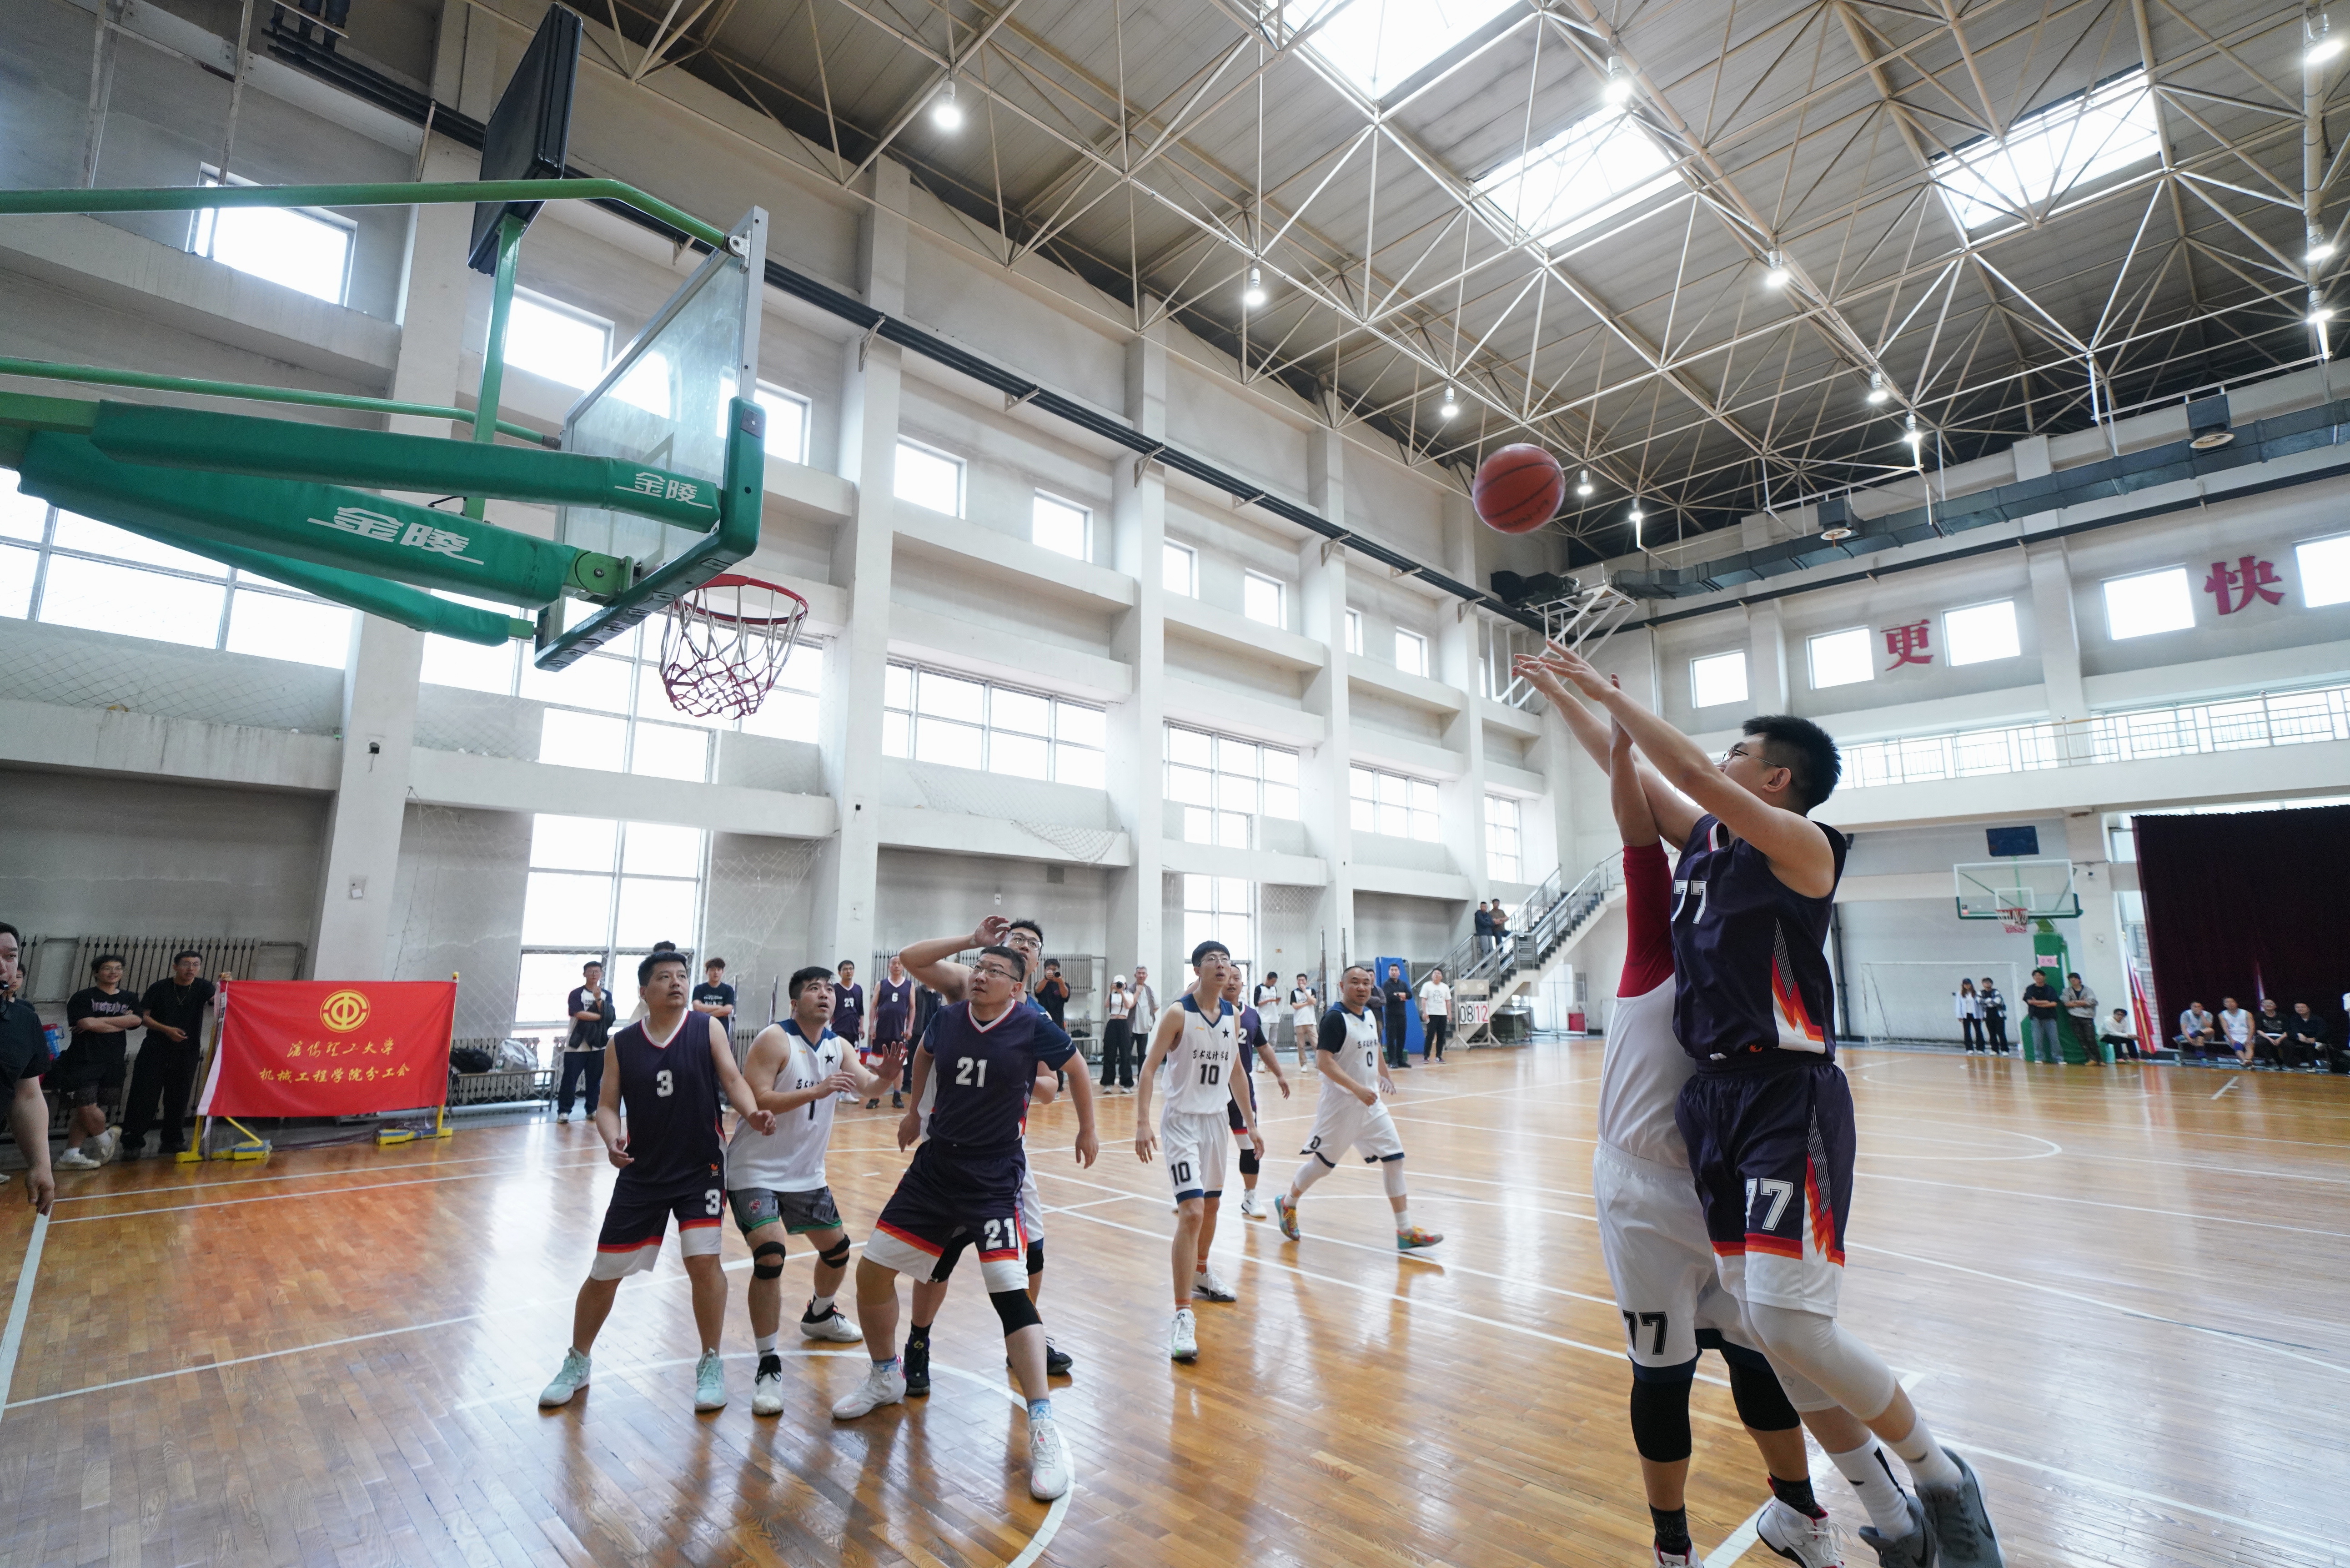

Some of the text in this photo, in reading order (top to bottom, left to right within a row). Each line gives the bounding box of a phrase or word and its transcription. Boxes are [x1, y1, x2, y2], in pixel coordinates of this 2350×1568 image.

[614, 472, 713, 509] 金陵
[306, 506, 484, 566] 金陵
[1880, 556, 2285, 672] 更 快
[1671, 879, 1707, 924] 77
[844, 997, 854, 1008] 29
[892, 992, 899, 1002] 6
[1366, 1050, 1373, 1067] 0
[259, 1062, 410, 1084] 机械工程学院分工会
[656, 1069, 673, 1097] 3
[955, 1056, 988, 1088] 21
[1200, 1063, 1220, 1086] 10
[1310, 1136, 1321, 1150] 0
[1171, 1161, 1191, 1187] 10
[705, 1189, 721, 1215] 3
[984, 1218, 1016, 1250] 21
